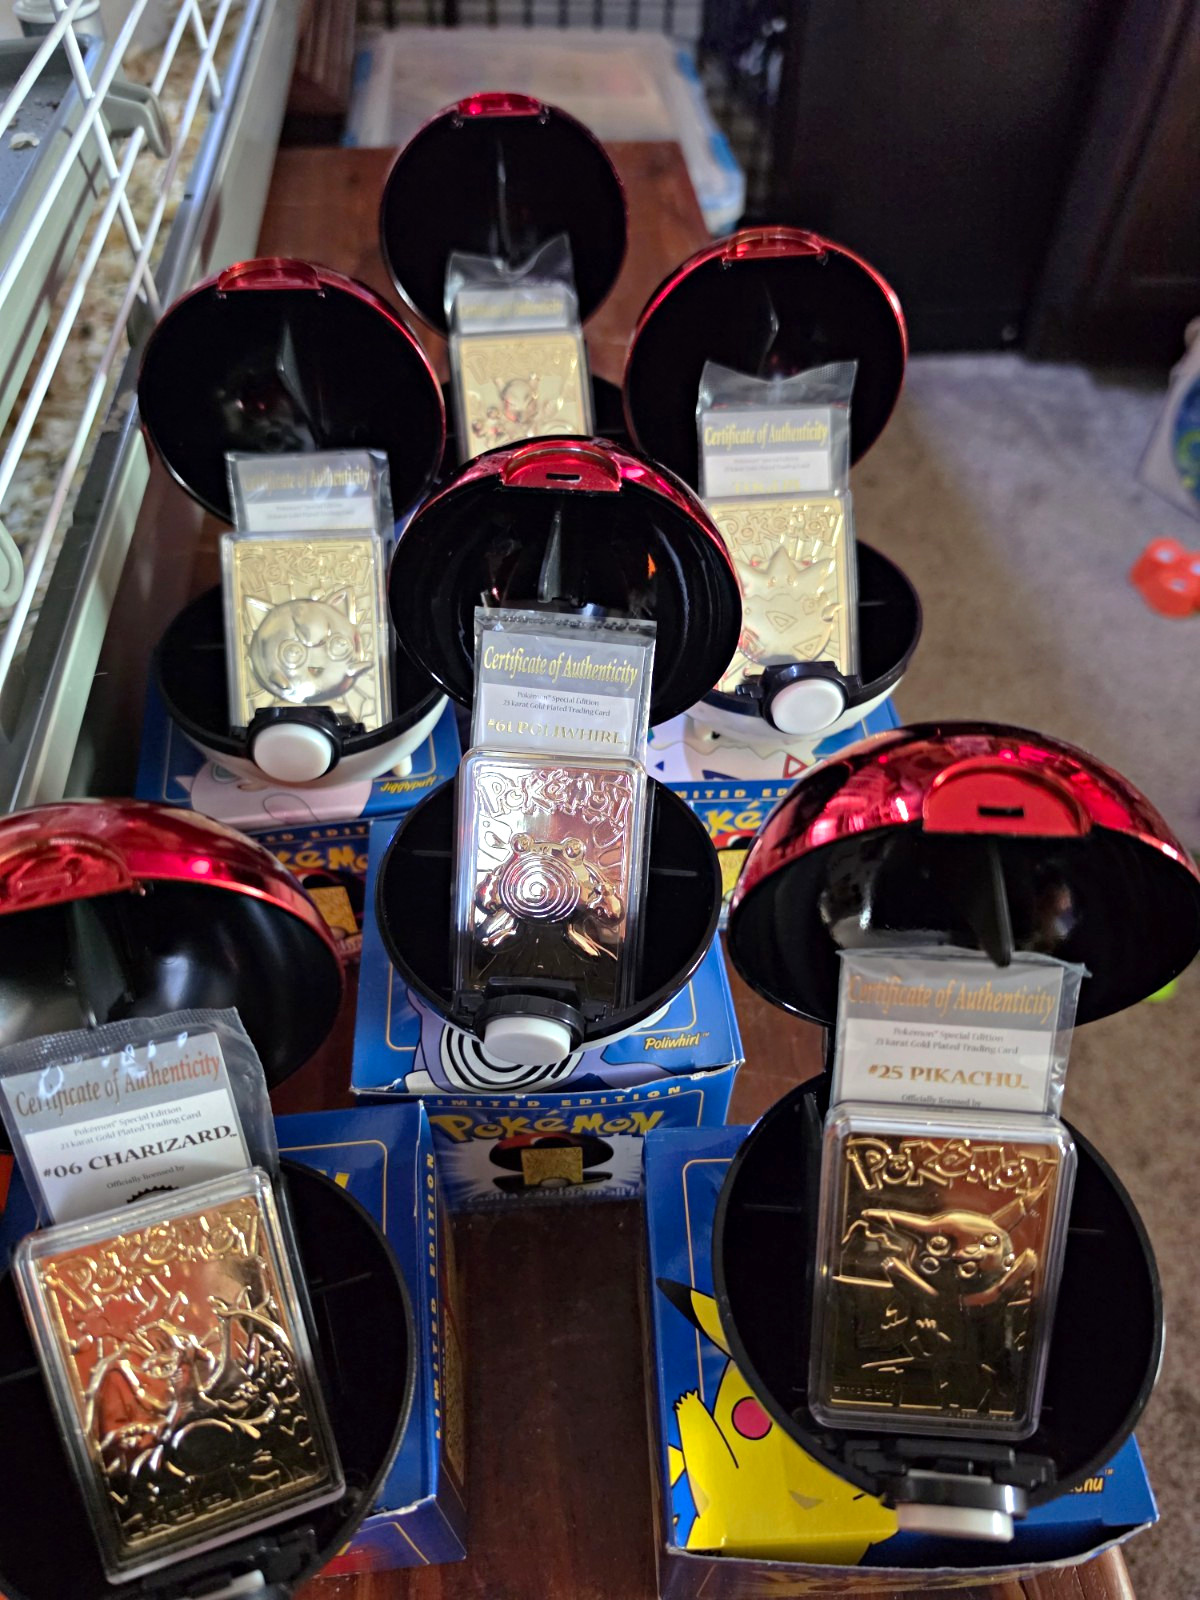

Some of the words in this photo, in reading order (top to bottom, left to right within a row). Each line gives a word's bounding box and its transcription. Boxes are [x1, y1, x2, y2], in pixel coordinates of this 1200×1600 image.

[705, 424, 754, 451] Certificate
[756, 421, 768, 449] of
[769, 420, 828, 447] Authenticity
[484, 646, 547, 679] Certificate
[548, 652, 565, 684] of
[561, 655, 638, 692] Authenticity
[530, 702, 545, 710] Gold
[546, 704, 567, 712] Plated
[568, 707, 594, 716] Trading
[594, 709, 611, 717] Card
[552, 695, 575, 703] Special
[575, 697, 600, 706] Edition
[488, 718, 513, 733] #61
[674, 788, 746, 799] MITED
[310, 826, 366, 838] EDIT
[848, 975, 932, 1015] Certificate
[935, 979, 957, 1017] of
[953, 980, 1055, 1025] Authenticity
[940, 1031, 970, 1041] Special
[972, 1033, 1004, 1042] Edition
[885, 1038, 909, 1047] karat
[910, 1039, 931, 1049] Gold
[932, 1041, 961, 1050] Plated
[962, 1043, 997, 1054] Trading
[998, 1046, 1019, 1055] Card
[868, 1064, 903, 1080] #25
[16, 1080, 101, 1117] Certificate
[105, 1069, 120, 1104] of
[125, 1051, 220, 1093] Authenticity
[561, 1086, 680, 1106] EDITION
[119, 1113, 148, 1126] Special
[150, 1106, 182, 1119] Edition
[71, 1137, 94, 1147] karat
[95, 1131, 116, 1141] Gold
[118, 1124, 145, 1137] Plated
[147, 1117, 181, 1130] Trading
[181, 1110, 202, 1121] Card
[44, 1162, 82, 1178] #06
[106, 1175, 141, 1189] Officially
[142, 1166, 174, 1180] licensed
[426, 1153, 436, 1278] EDITION
